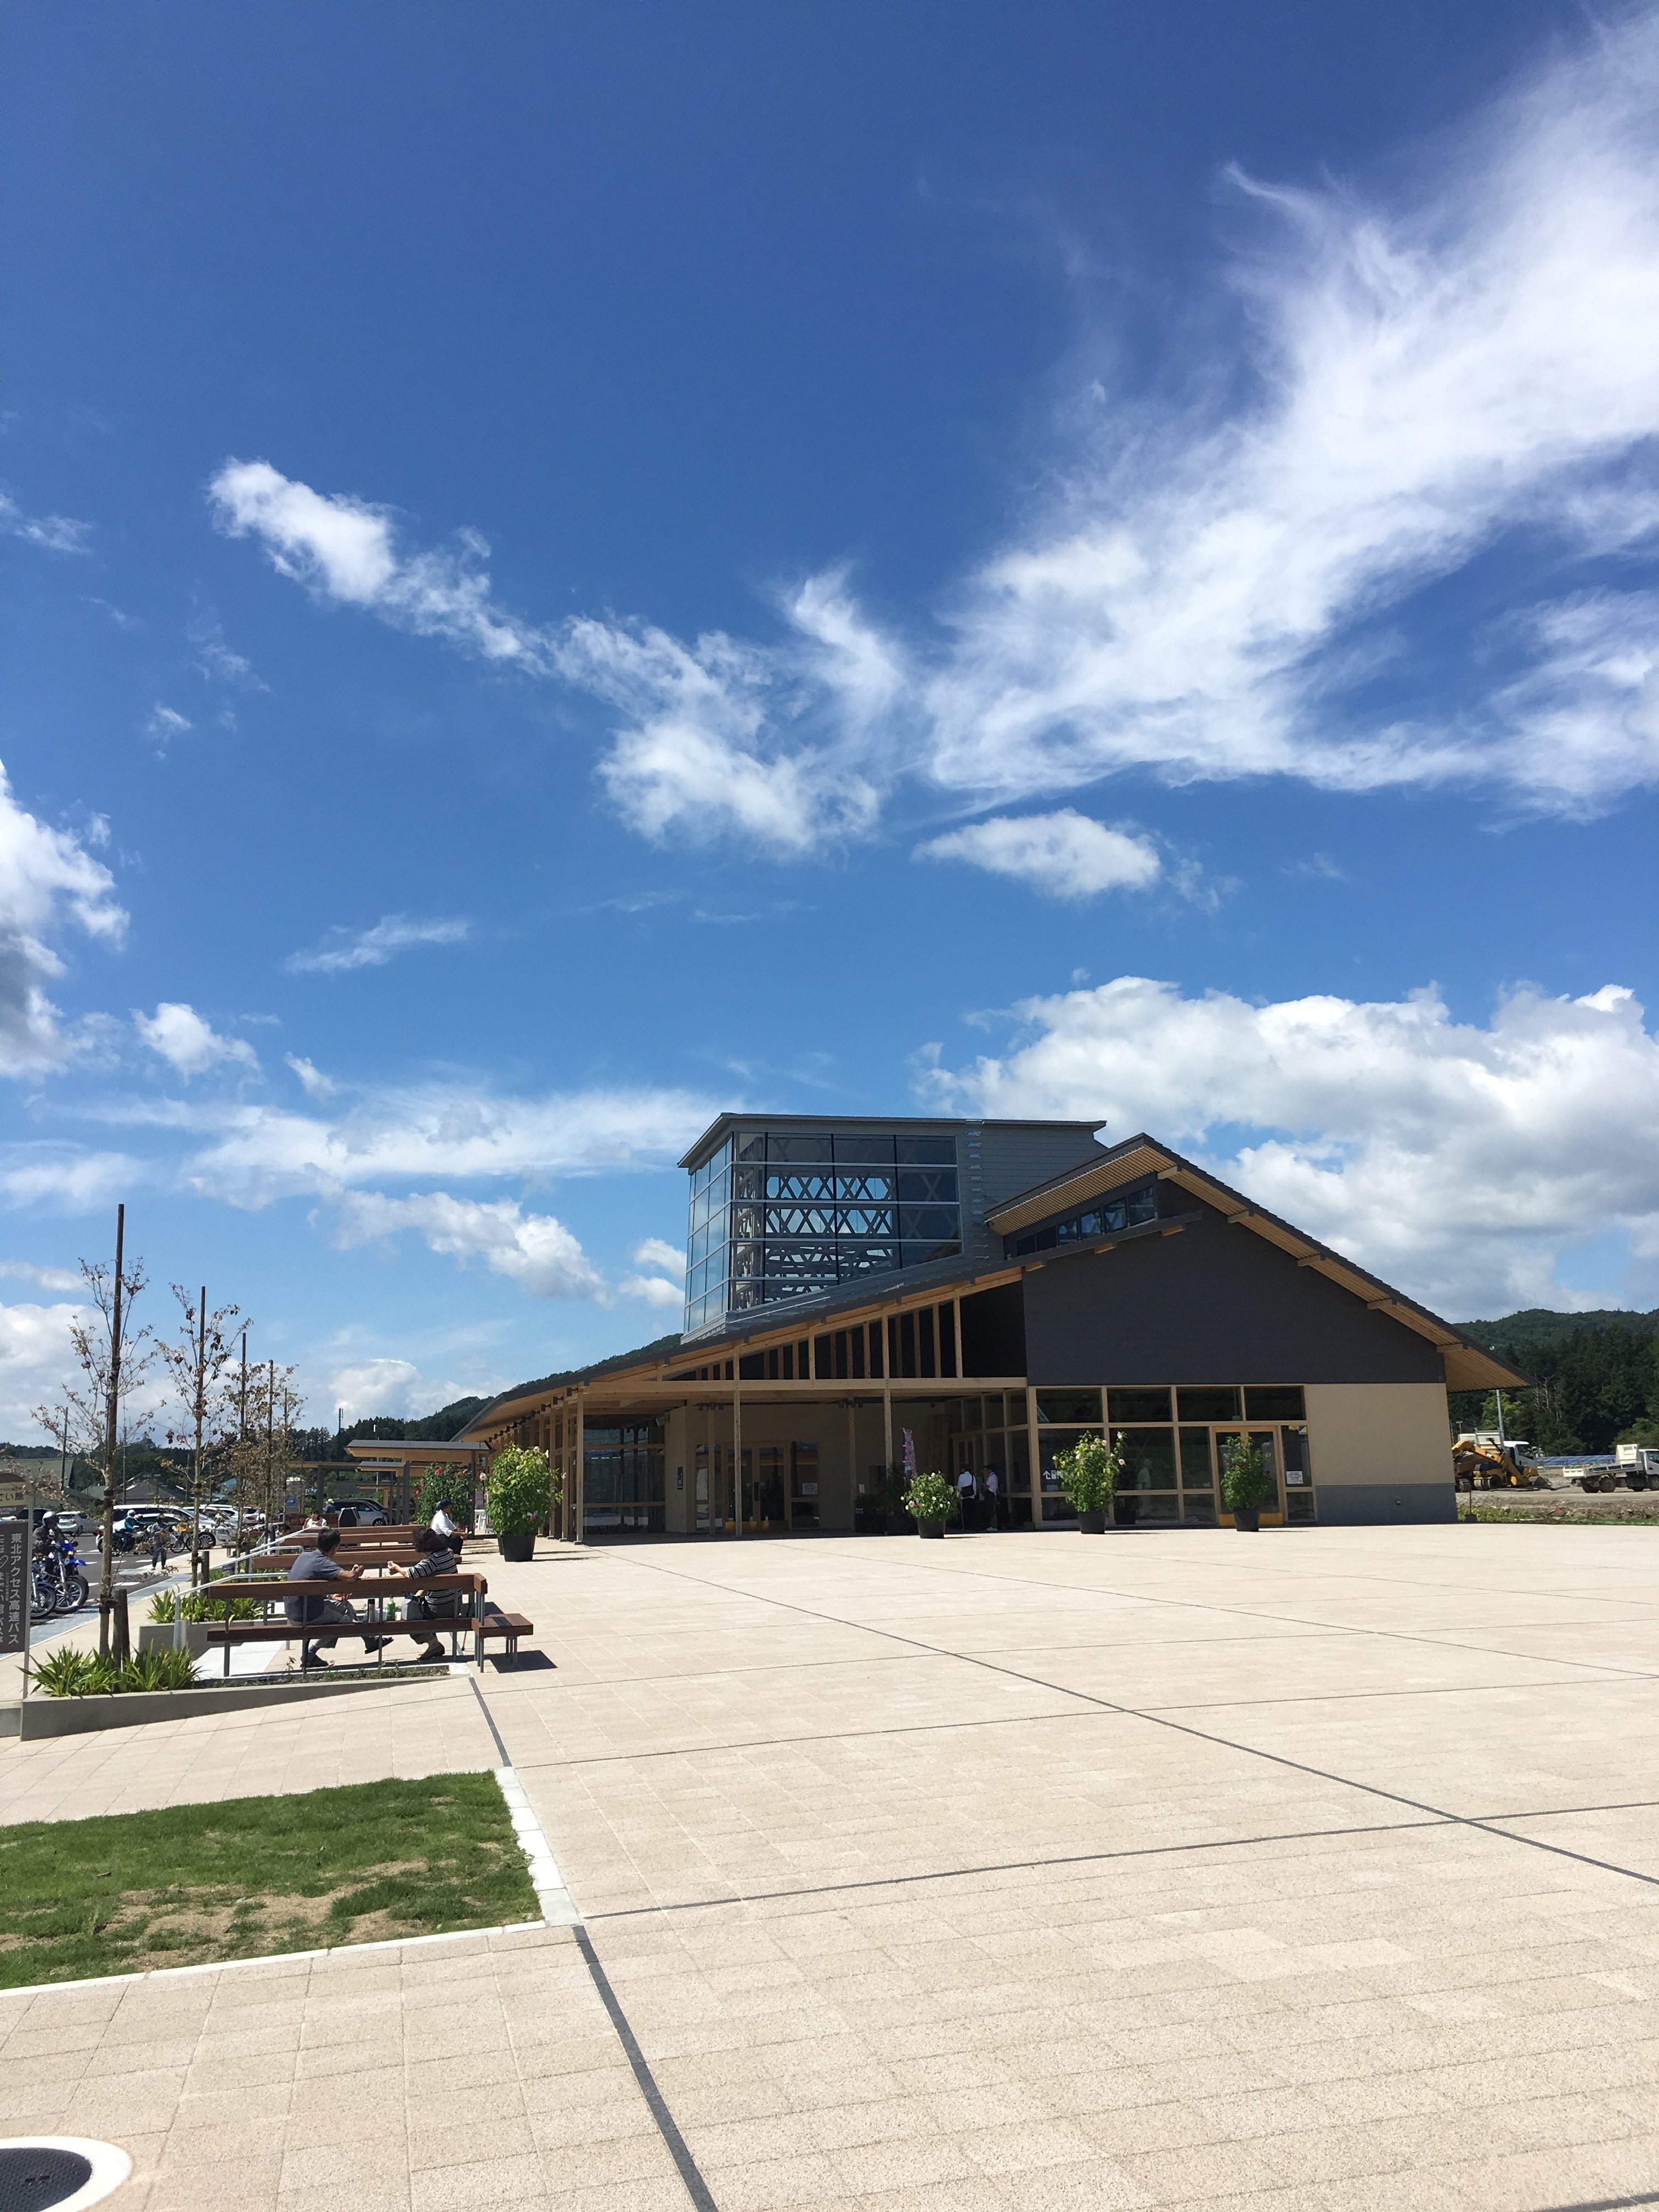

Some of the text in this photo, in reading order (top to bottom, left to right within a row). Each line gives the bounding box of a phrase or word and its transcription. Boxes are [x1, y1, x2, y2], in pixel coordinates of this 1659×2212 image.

[8, 1533, 22, 1645] 東北アクセス高速バス
